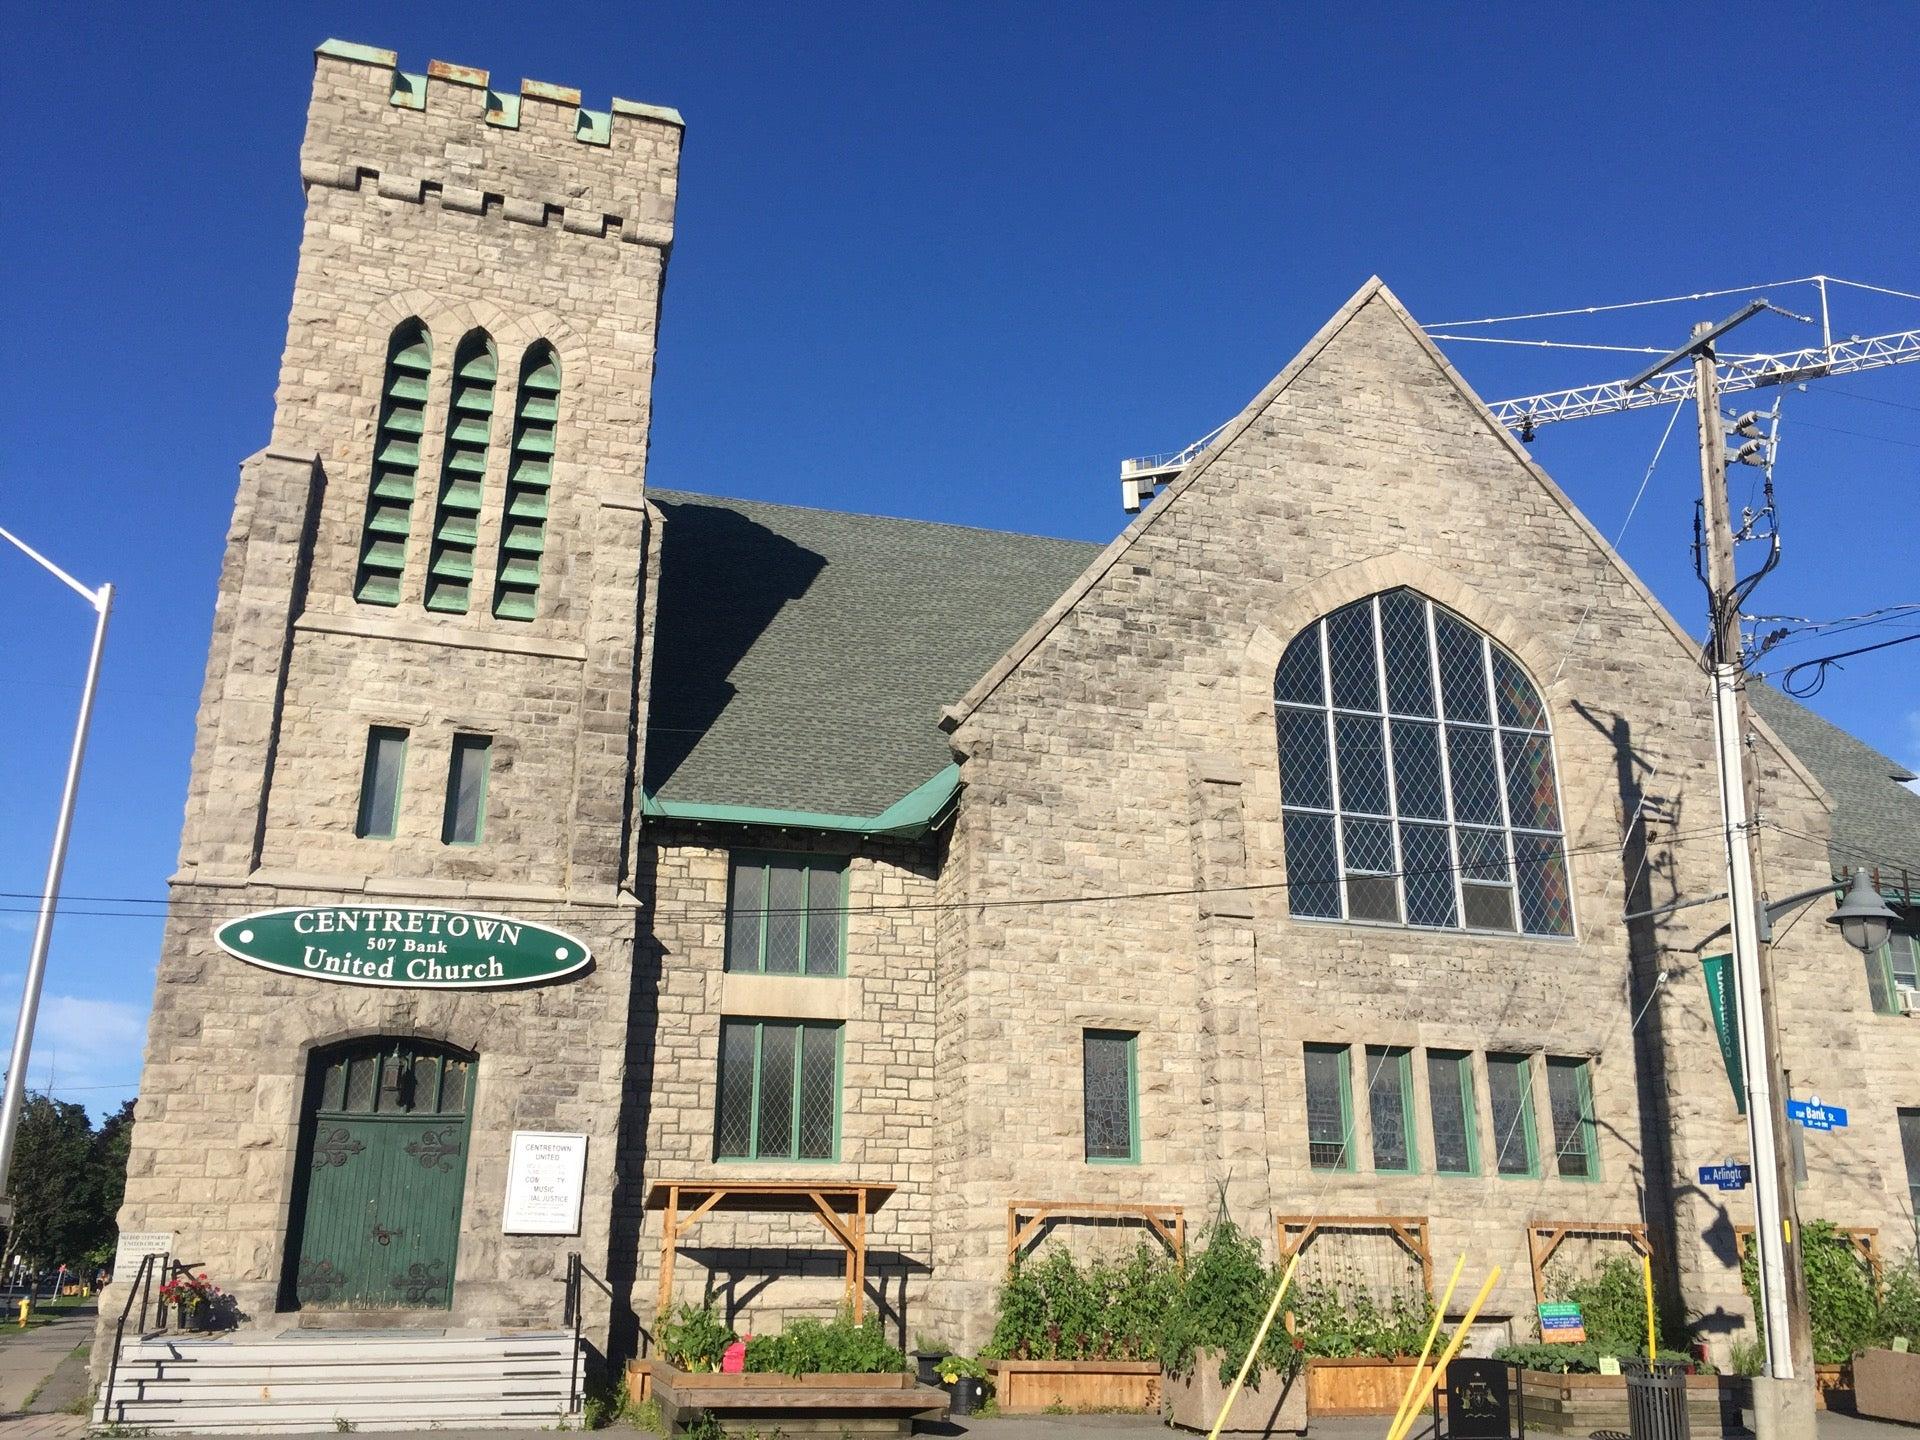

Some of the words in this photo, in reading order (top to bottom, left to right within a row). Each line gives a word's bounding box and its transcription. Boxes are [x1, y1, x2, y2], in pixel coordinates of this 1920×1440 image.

[294, 911, 522, 946] CENTRETOWN
[366, 937, 397, 951] 507
[402, 939, 448, 954] Bank
[303, 946, 396, 978] United
[406, 956, 505, 980] Church
[1805, 1106, 1826, 1120] Bank
[525, 1144, 572, 1152] CENTRETOWN
[535, 1153, 560, 1161] UNITED
[533, 1185, 555, 1193] MUSIC
[541, 1195, 569, 1203] JUSTICE
